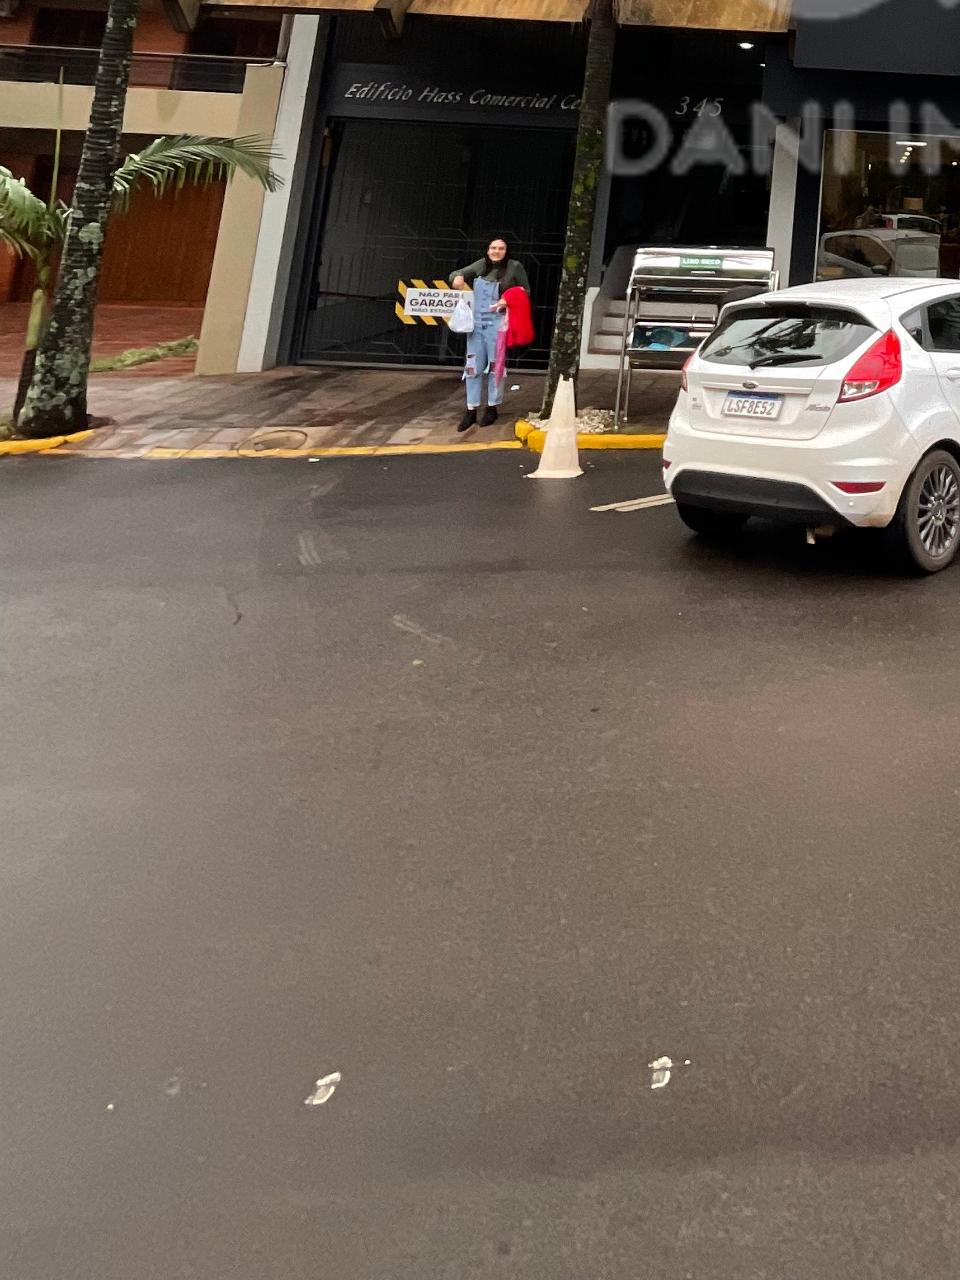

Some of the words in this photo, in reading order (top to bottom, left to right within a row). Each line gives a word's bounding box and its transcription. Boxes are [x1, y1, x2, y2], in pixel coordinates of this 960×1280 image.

[417, 86, 463, 104] Hass
[469, 89, 557, 109] Comercial
[674, 96, 724, 117] 345
[726, 399, 776, 416] LSF8E52
